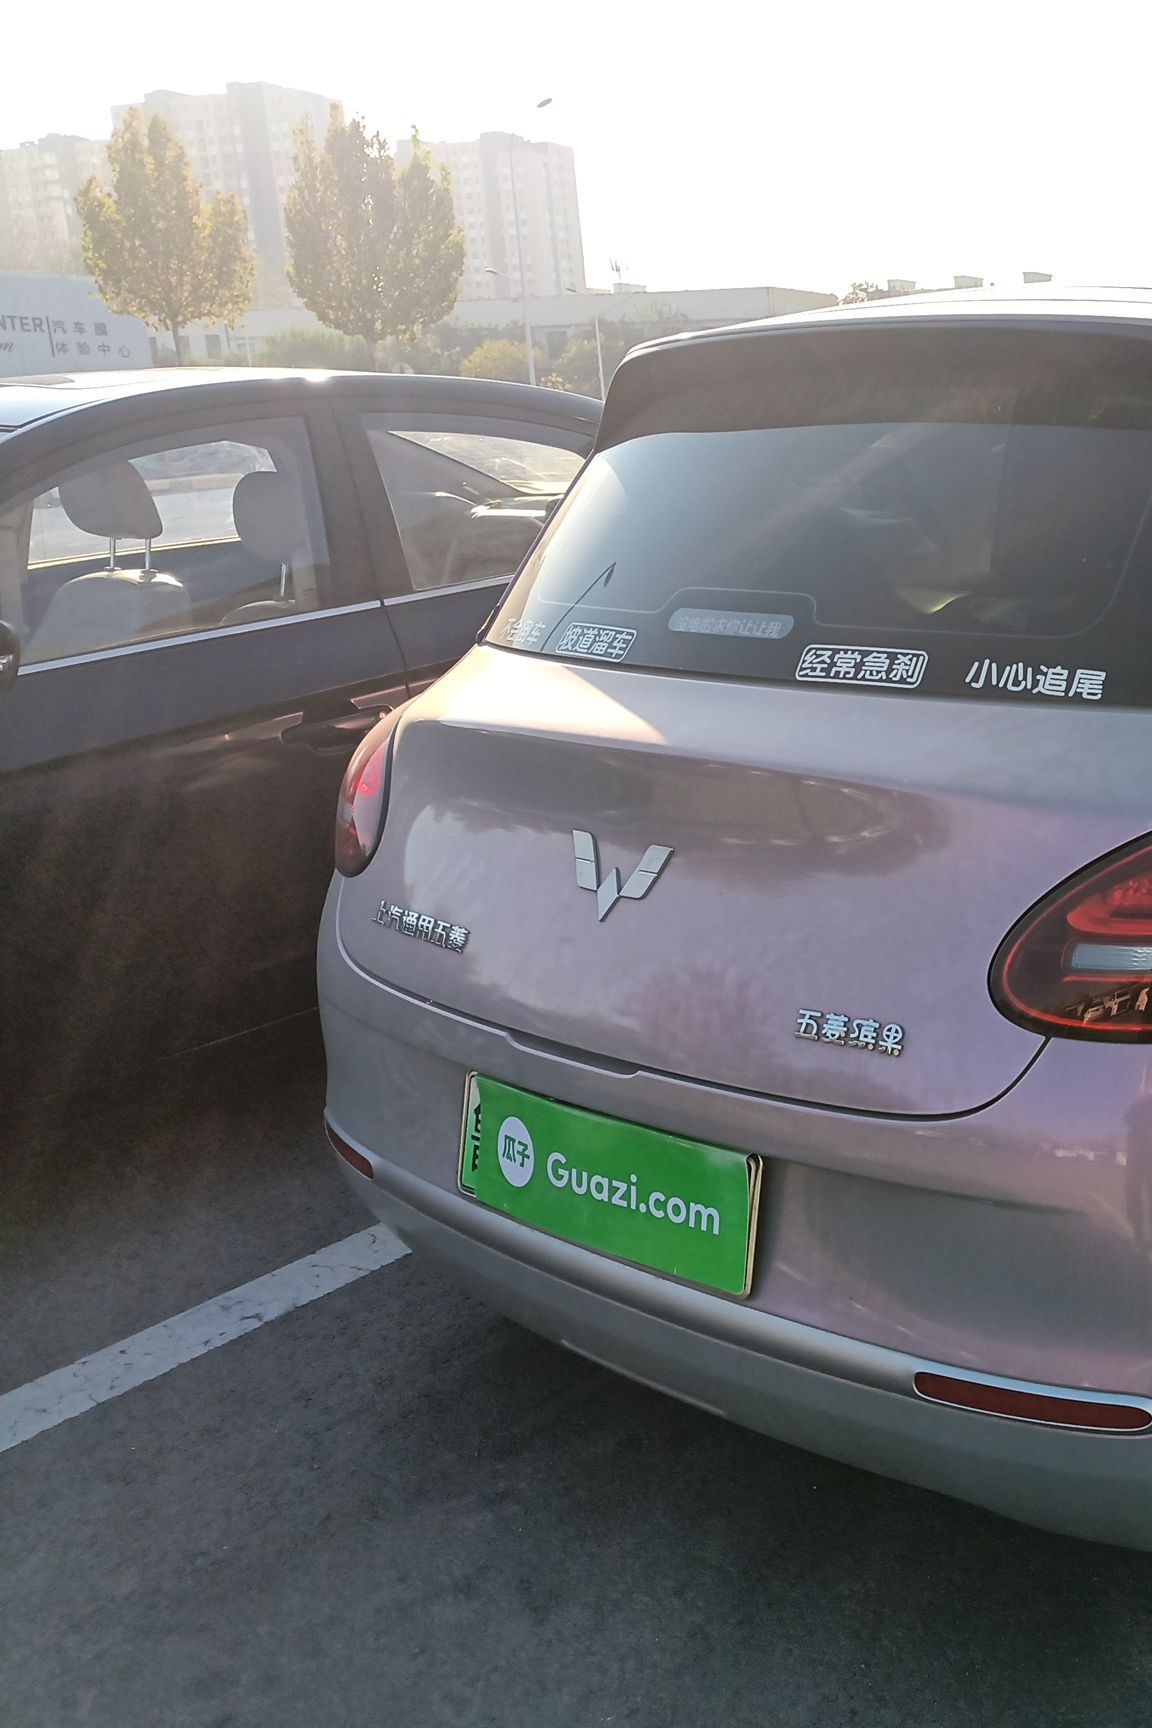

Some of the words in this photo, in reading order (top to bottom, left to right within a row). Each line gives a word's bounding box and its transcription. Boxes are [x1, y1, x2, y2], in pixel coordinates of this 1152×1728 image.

[560, 626, 632, 658] 坡道溜车
[799, 649, 925, 683] 经常急刹
[964, 658, 1107, 701] 小心追尾
[502, 1133, 531, 1168] 瓜子
[546, 1151, 720, 1236] Guazi.com
